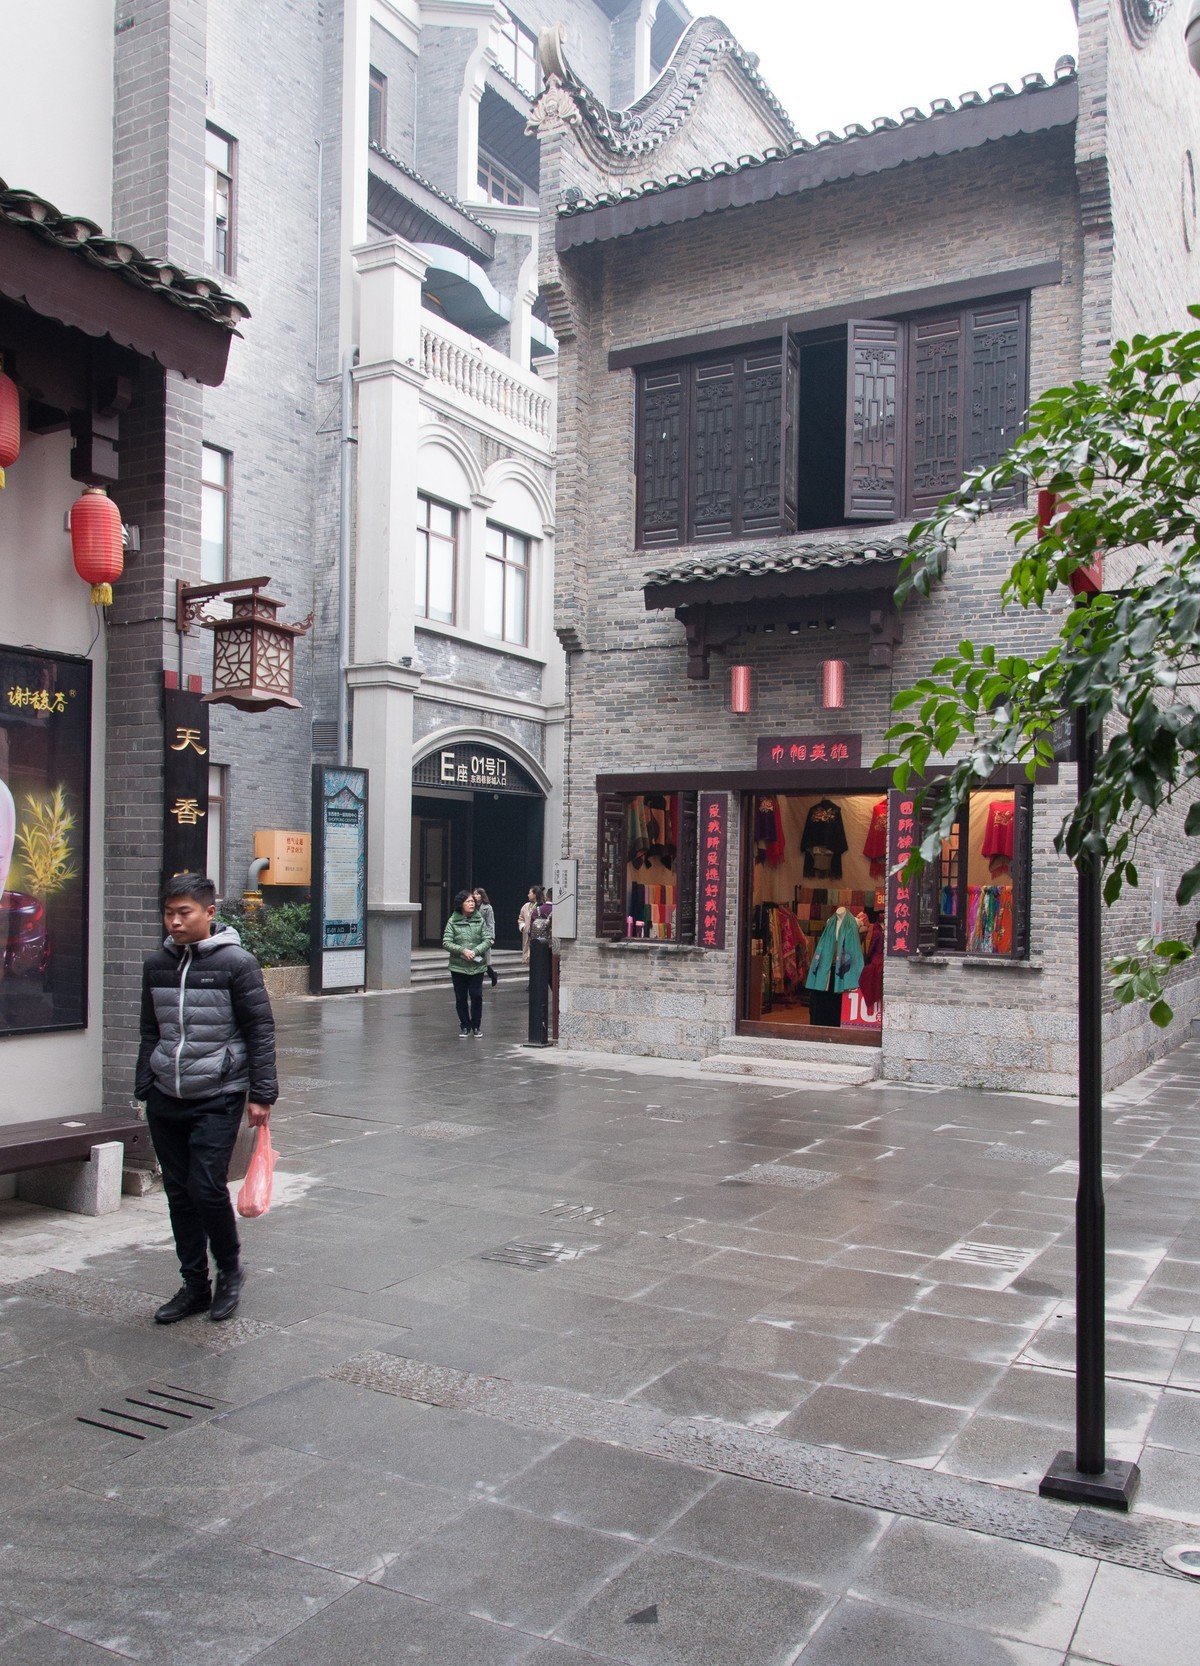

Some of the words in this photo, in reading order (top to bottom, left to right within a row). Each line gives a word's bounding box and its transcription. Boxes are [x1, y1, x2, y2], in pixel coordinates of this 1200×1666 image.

[7, 685, 68, 713] 谢馥春
[771, 742, 849, 763] 巾帼英雄
[170, 727, 207, 877] 天香
